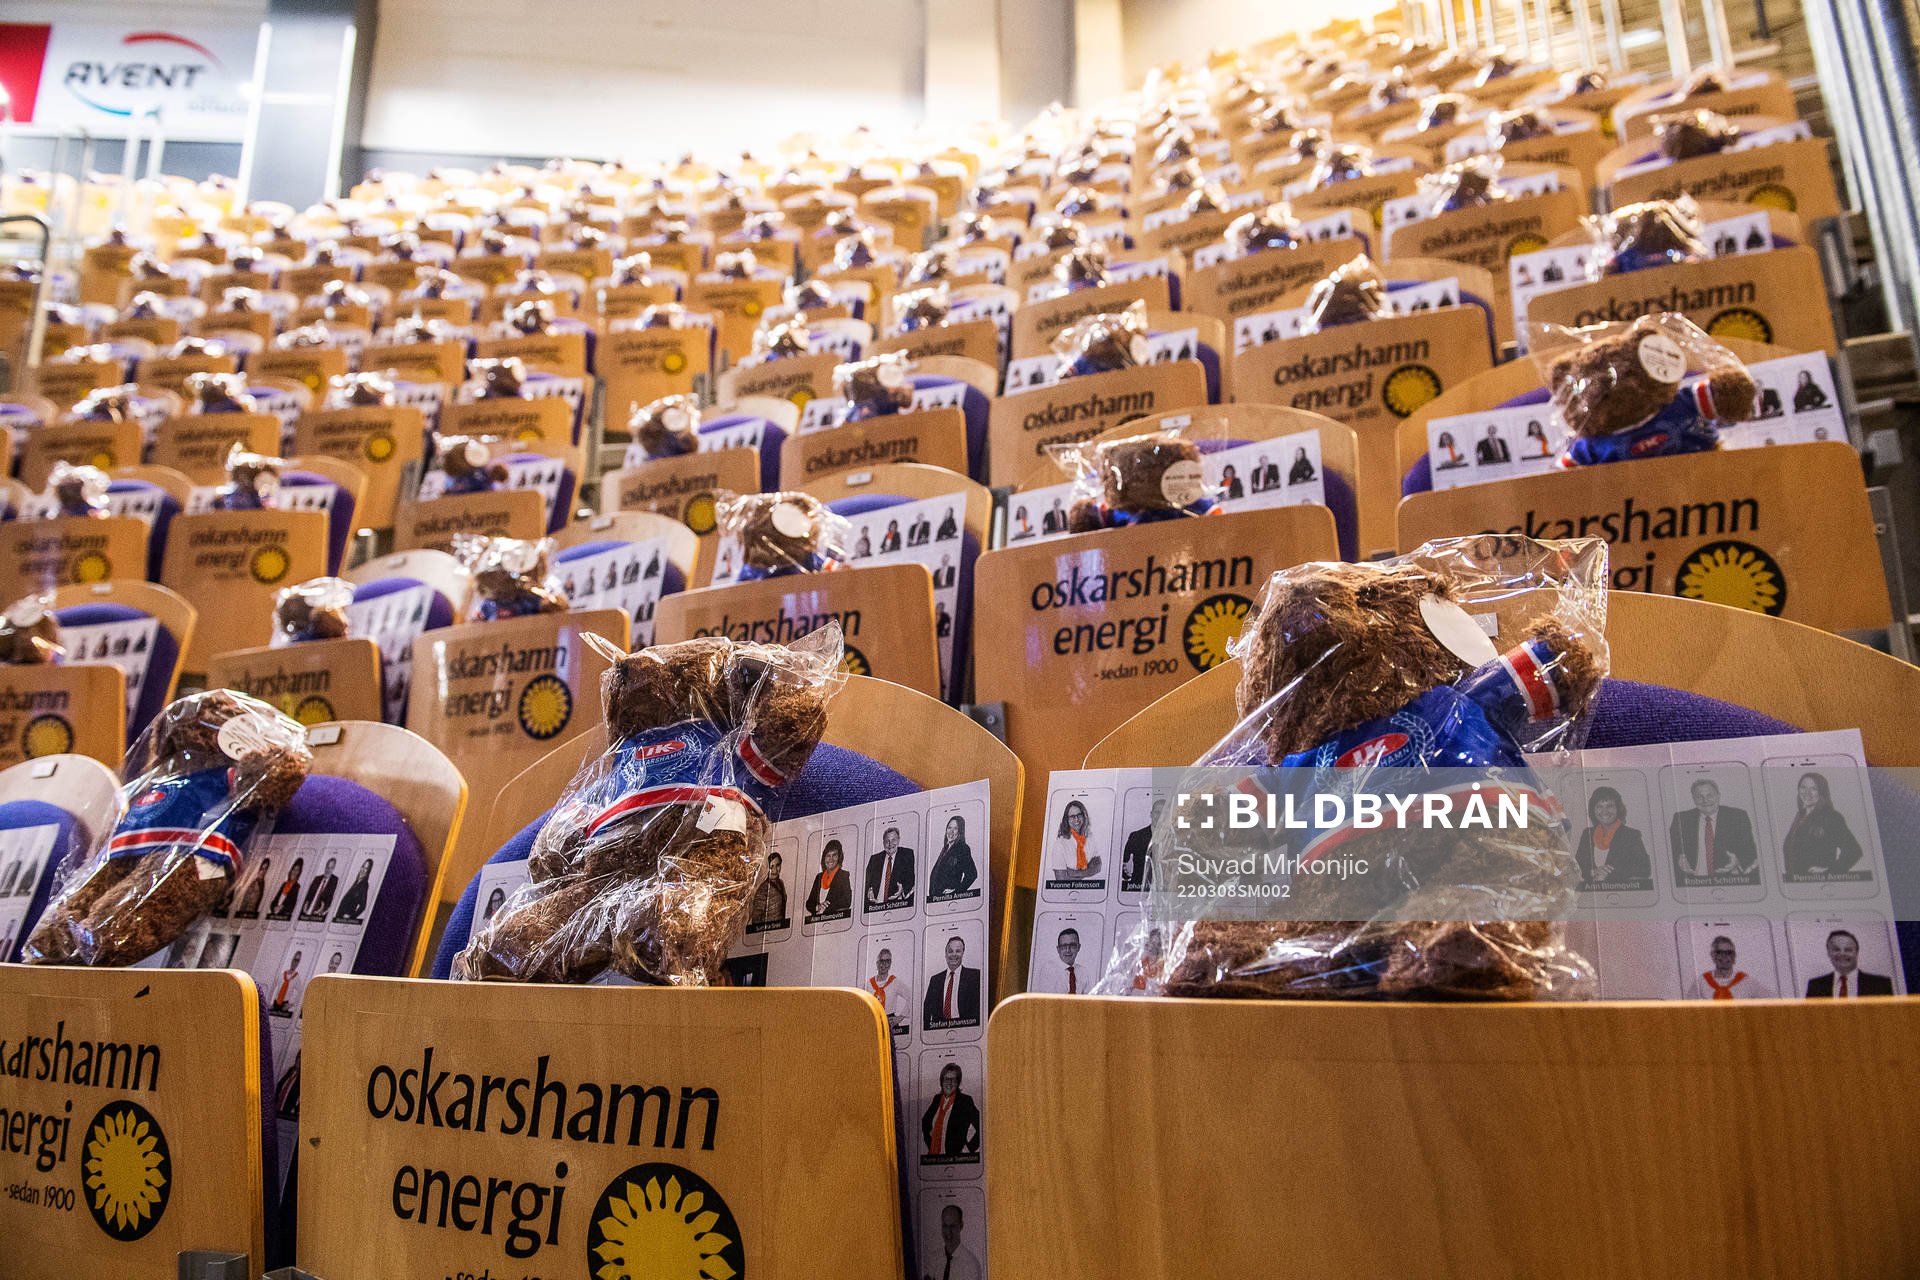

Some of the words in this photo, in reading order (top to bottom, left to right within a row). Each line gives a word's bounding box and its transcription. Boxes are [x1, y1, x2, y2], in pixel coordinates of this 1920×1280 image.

[64, 61, 206, 88] AVENT
[1274, 337, 1430, 386] oskarshamn
[1023, 389, 1155, 432] oskarshamn
[1291, 373, 1374, 409] energi
[805, 435, 918, 474] oskarshamn
[1474, 497, 1760, 561] oskarshamn
[1031, 554, 1254, 611] oskarshamn
[1053, 603, 1170, 656] energi
[449, 643, 568, 679] skarshamn
[1143, 658, 1179, 677] 1900
[446, 680, 513, 719] energi
[1601, 881, 1640, 890] Blomqvist
[929, 1021, 947, 1029] Stefan
[948, 1018, 977, 1027] Johansson
[366, 1046, 720, 1150] oskarshamn
[44, 1184, 75, 1212] 1900
[392, 1161, 569, 1259] energi
